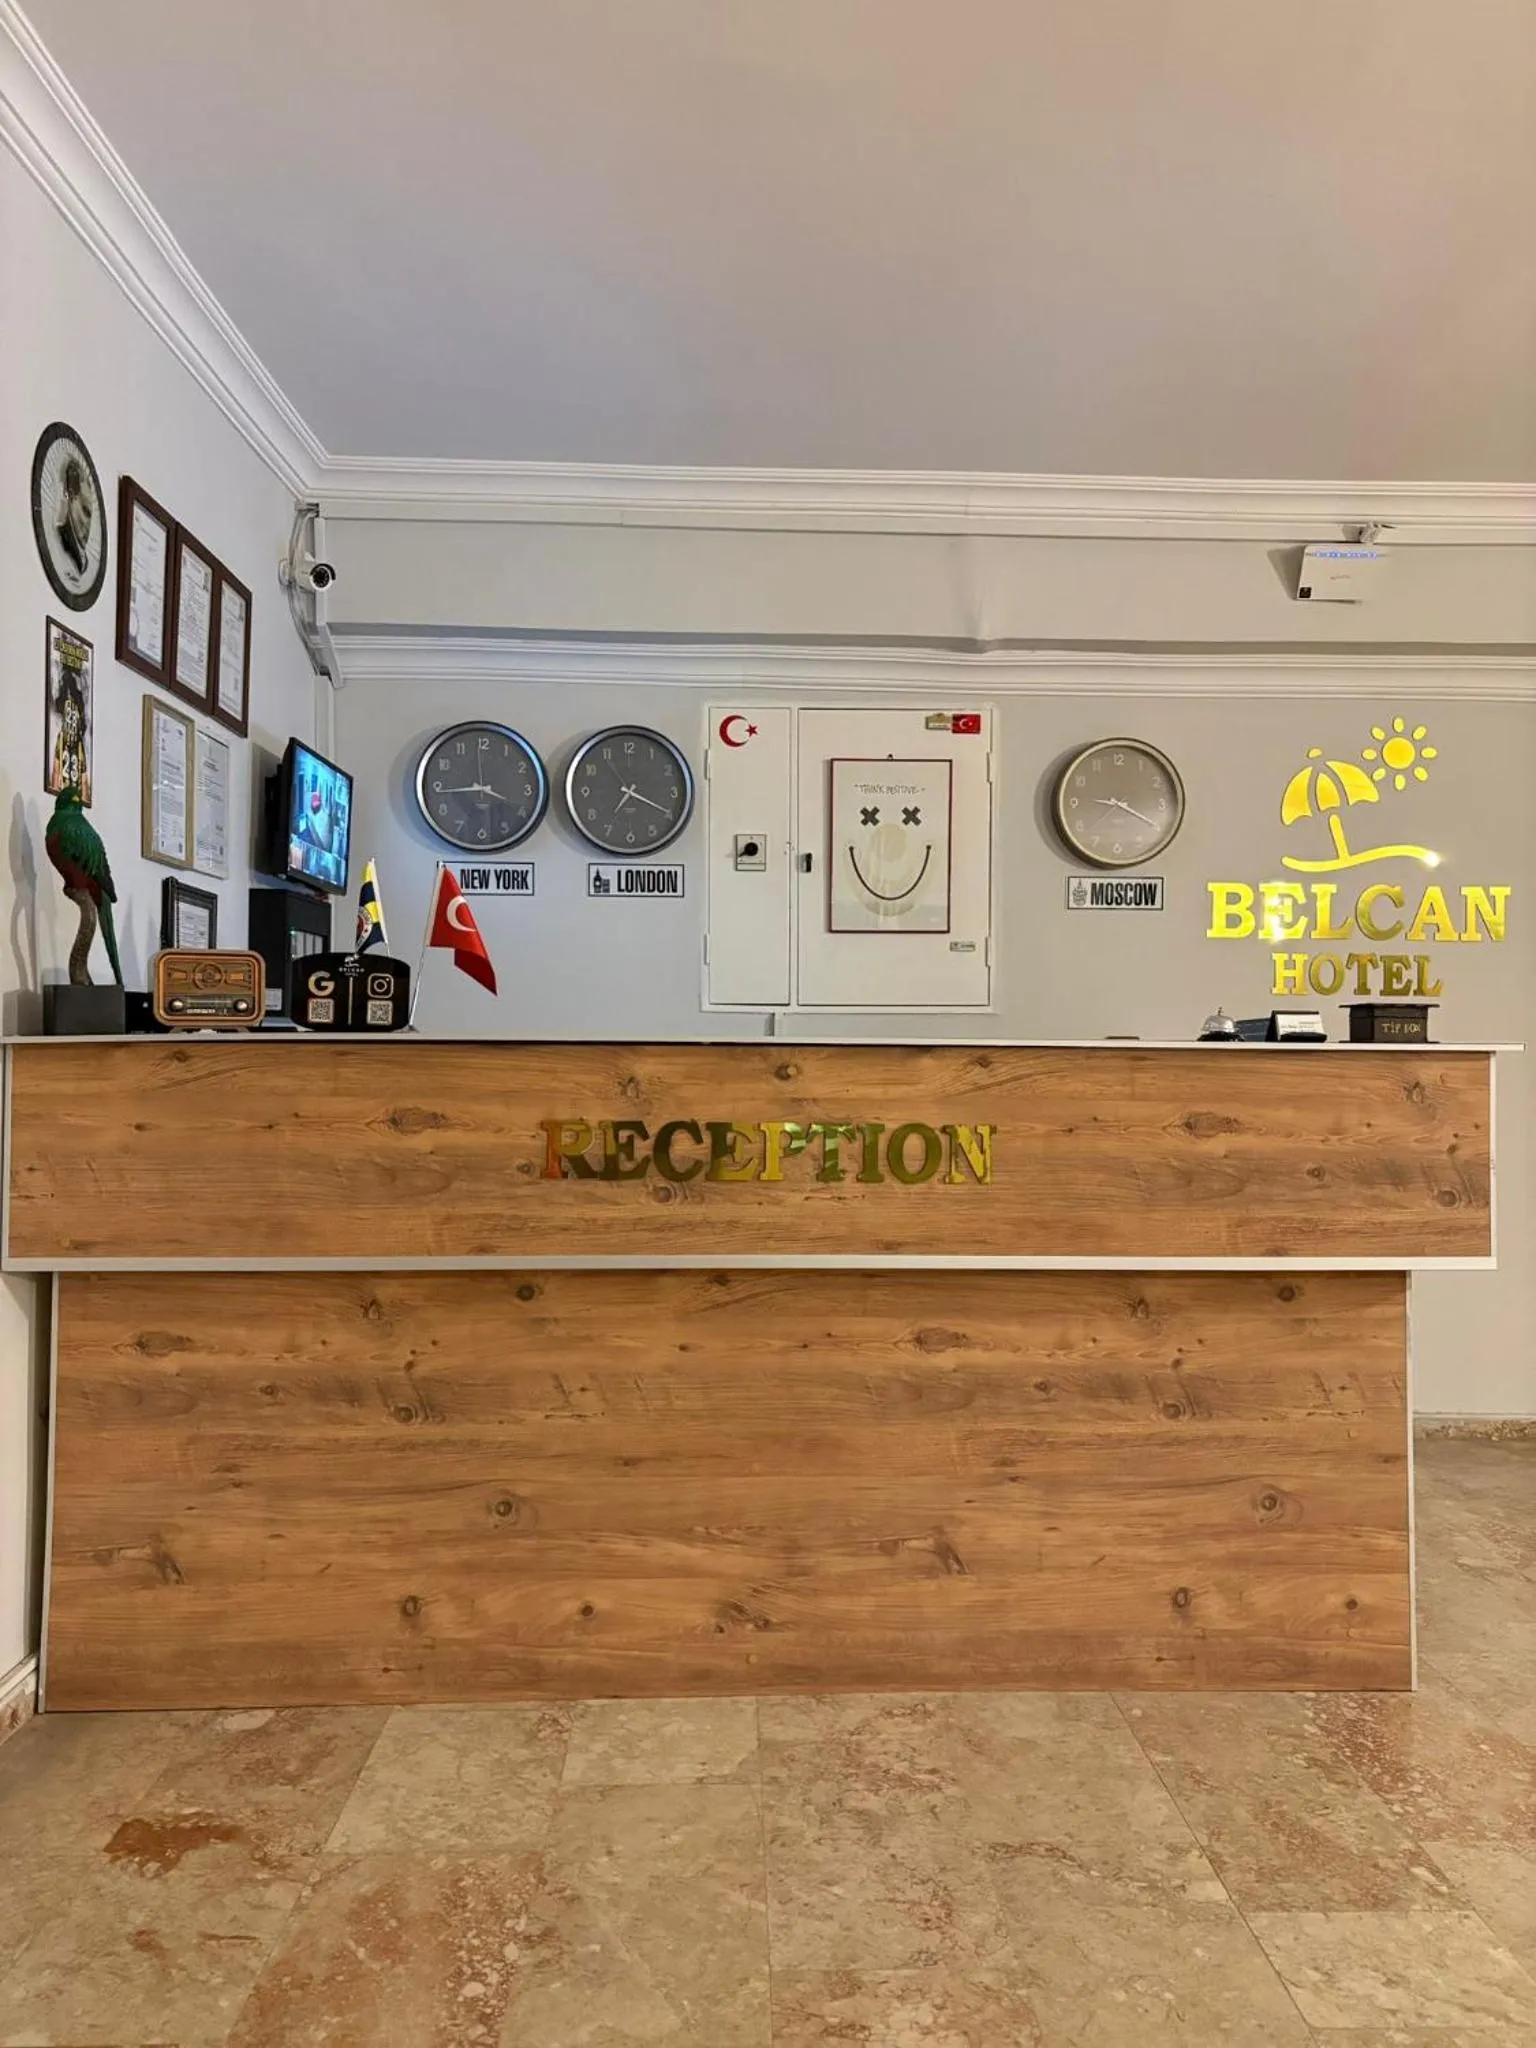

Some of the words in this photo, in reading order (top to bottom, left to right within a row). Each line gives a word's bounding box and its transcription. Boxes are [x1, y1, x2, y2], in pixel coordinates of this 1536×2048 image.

[63, 750, 78, 781] 23
[460, 868, 490, 890] NEW
[495, 869, 529, 891] YORK
[617, 869, 678, 893] LONDON
[1090, 882, 1158, 906] MOSCOW
[1206, 881, 1511, 941] BELCAN
[308, 970, 335, 996] G
[1271, 952, 1443, 996] HOTEL
[540, 1119, 997, 1185] RECEPTION
